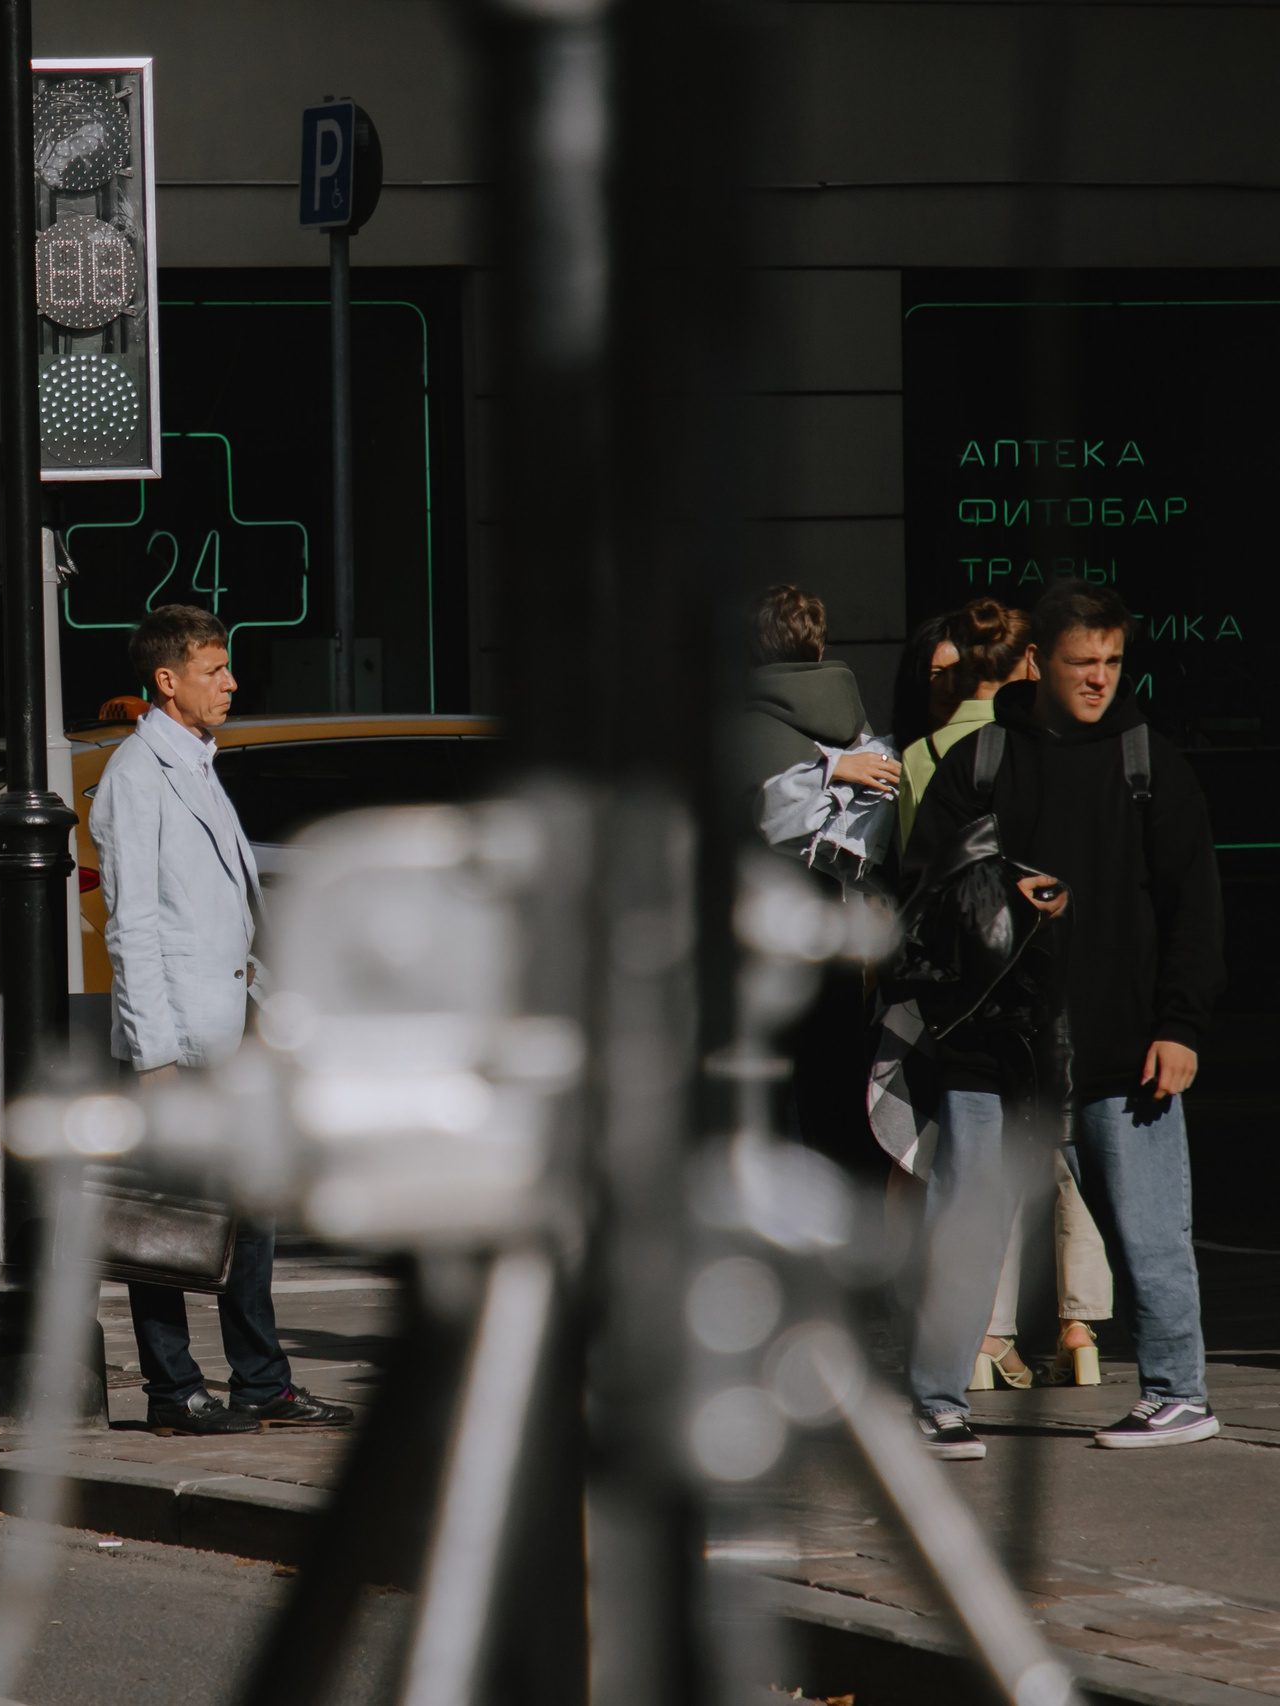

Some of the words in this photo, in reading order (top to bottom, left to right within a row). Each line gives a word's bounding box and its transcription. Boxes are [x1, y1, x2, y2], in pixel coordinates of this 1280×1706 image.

[314, 118, 343, 211] P
[958, 439, 1146, 467] АПТЕКА
[958, 497, 1188, 528] ФИТОБАР
[145, 529, 228, 616] 24
[958, 557, 1117, 587] ТРАВЫ
